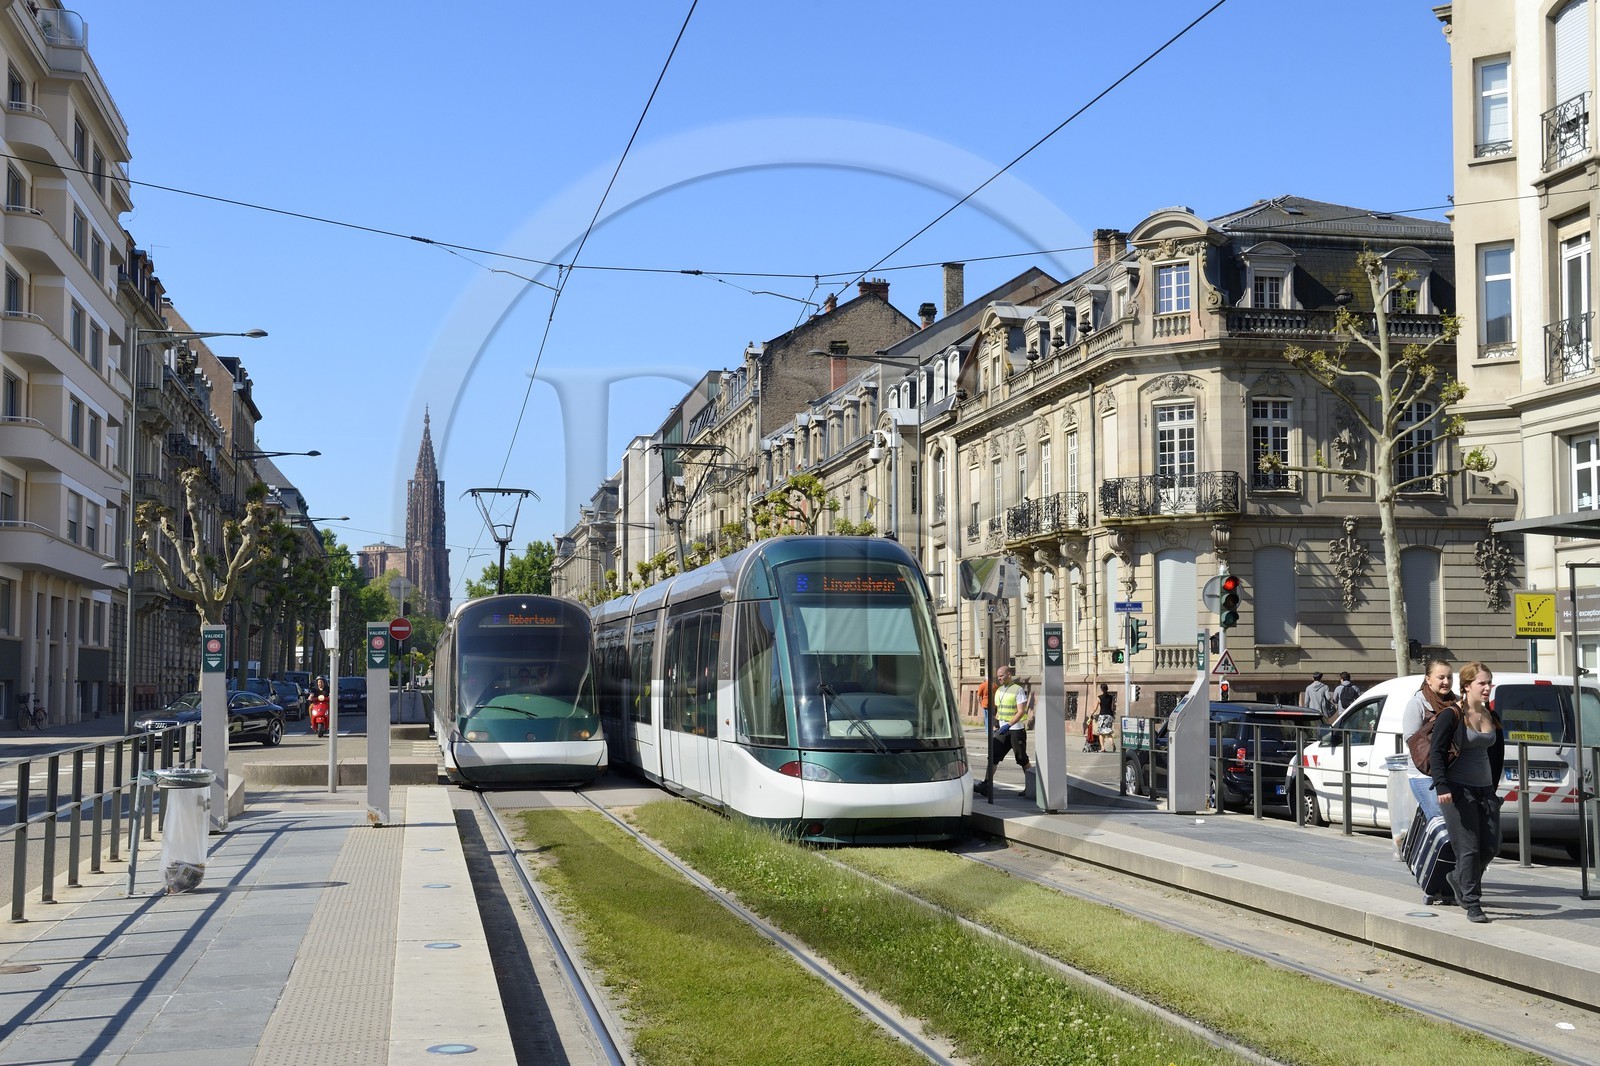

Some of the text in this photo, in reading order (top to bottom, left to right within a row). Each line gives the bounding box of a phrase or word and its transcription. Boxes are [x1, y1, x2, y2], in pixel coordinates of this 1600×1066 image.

[797, 574, 808, 592] B
[508, 614, 556, 625] Robertsau
[1527, 733, 1550, 742] FREQUENT
